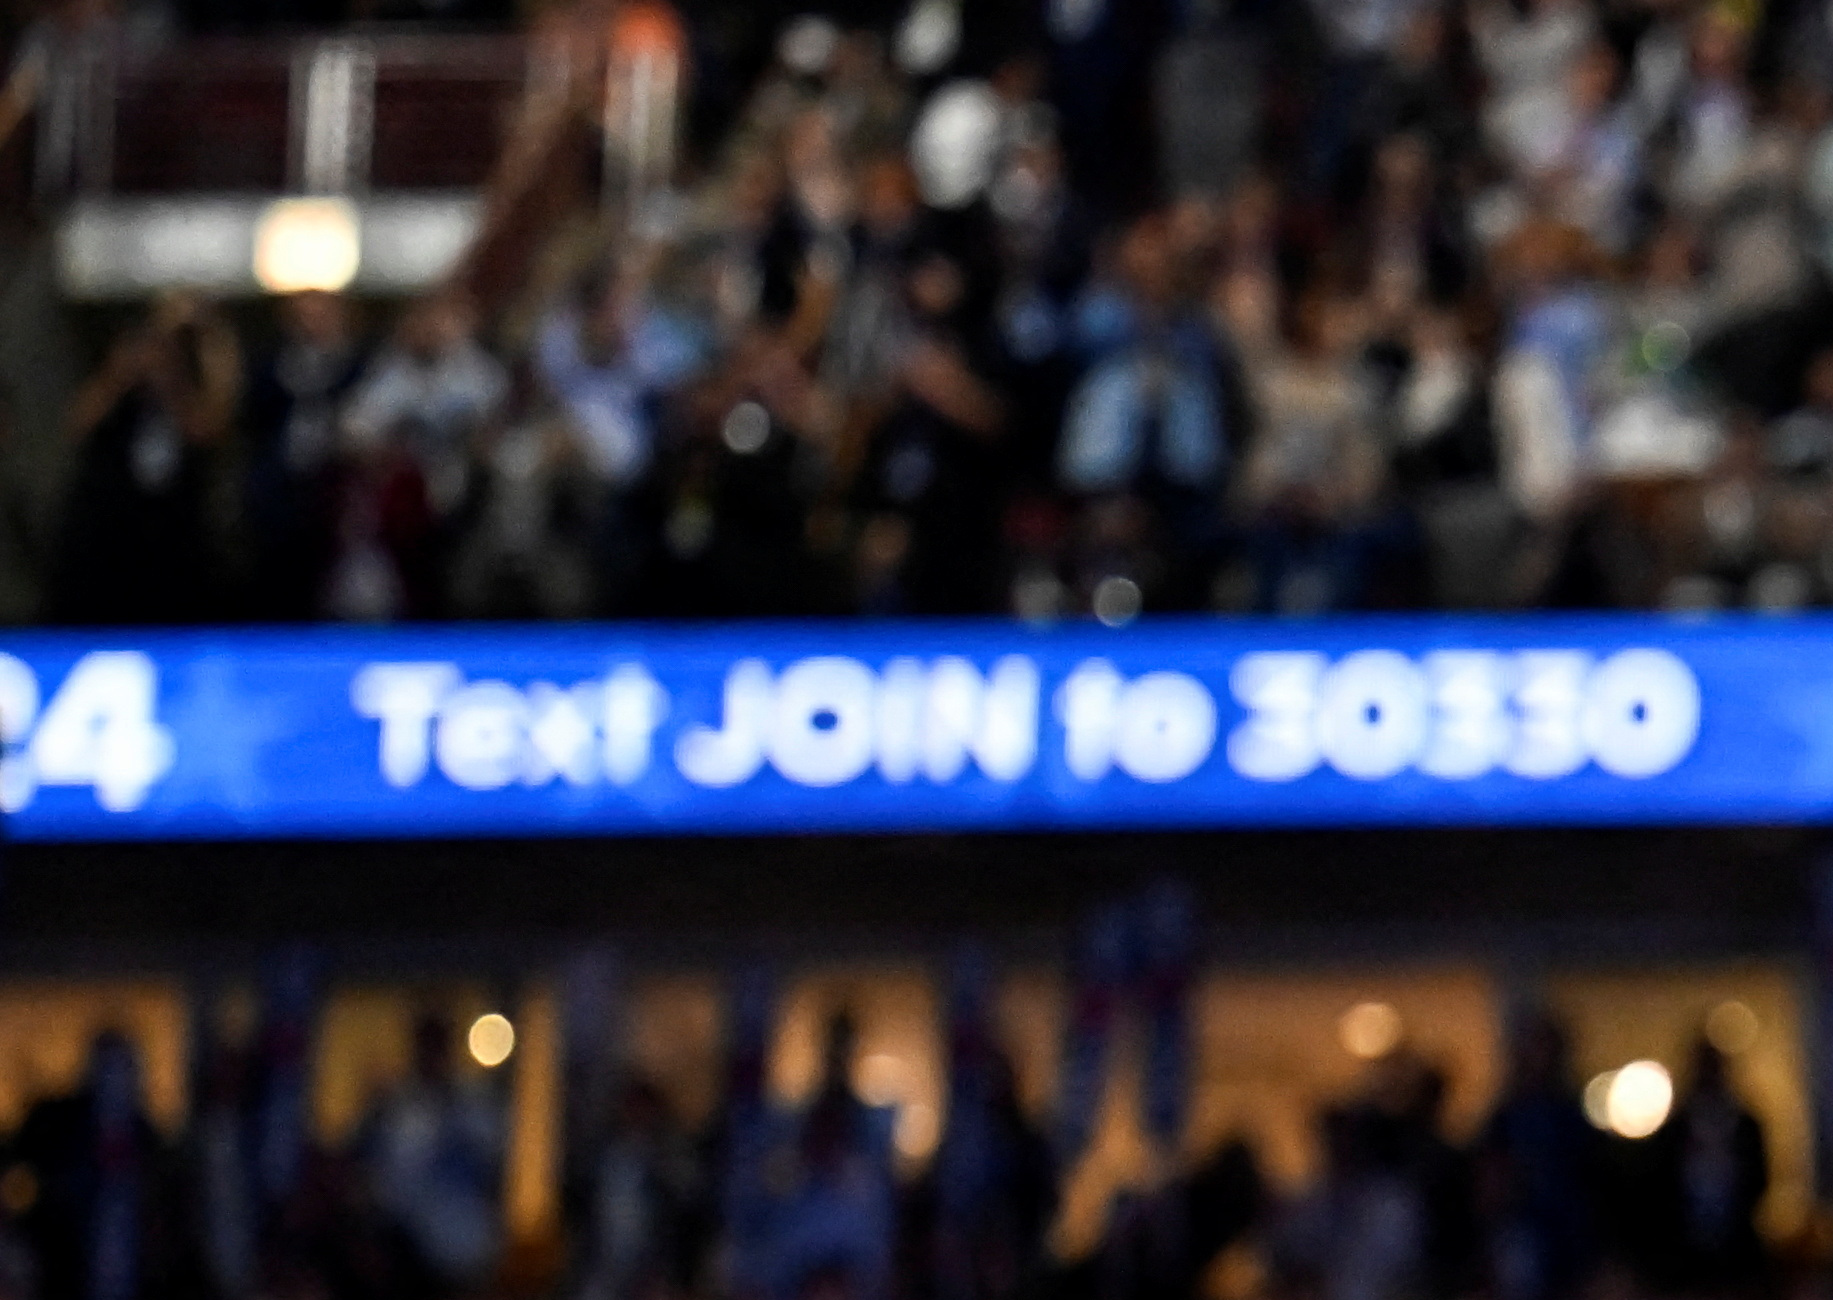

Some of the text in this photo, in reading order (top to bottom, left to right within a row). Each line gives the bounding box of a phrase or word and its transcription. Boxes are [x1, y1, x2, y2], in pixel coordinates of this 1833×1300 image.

[350, 647, 1702, 791] Text JOIN to 30330
